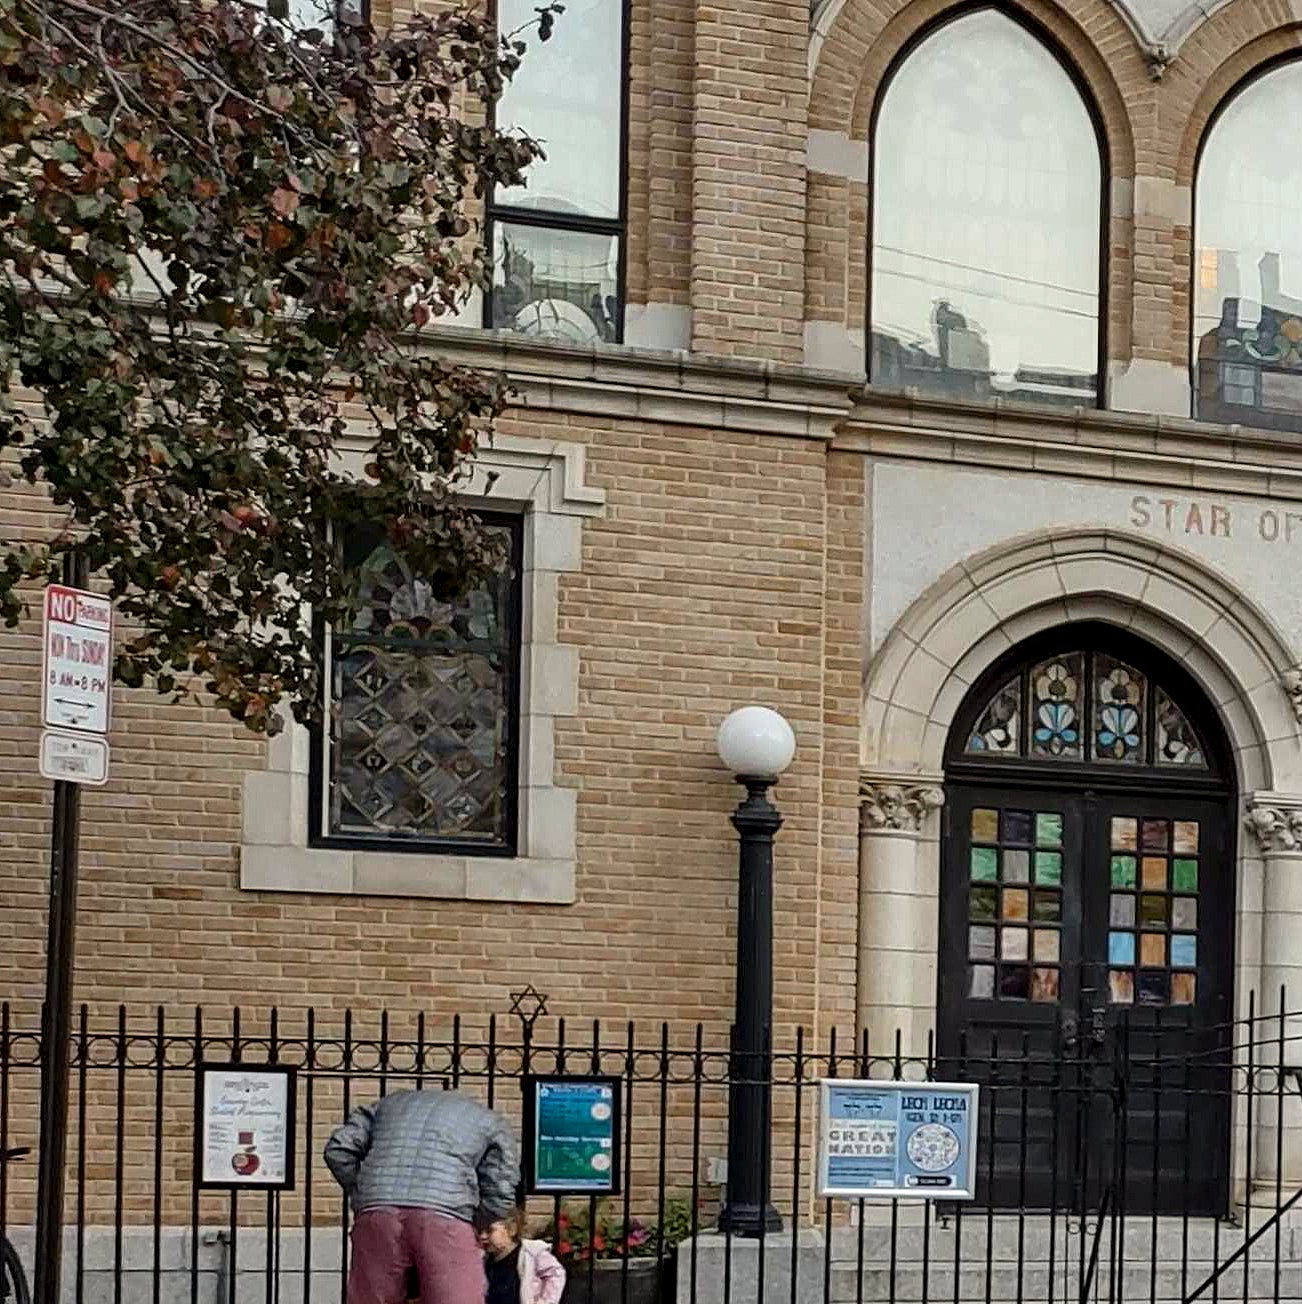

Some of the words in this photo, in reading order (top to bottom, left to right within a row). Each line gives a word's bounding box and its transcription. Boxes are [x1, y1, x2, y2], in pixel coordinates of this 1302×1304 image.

[1130, 496, 1231, 537] STAR
[50, 591, 75, 622] NO
[829, 1130, 897, 1143] GREAT
